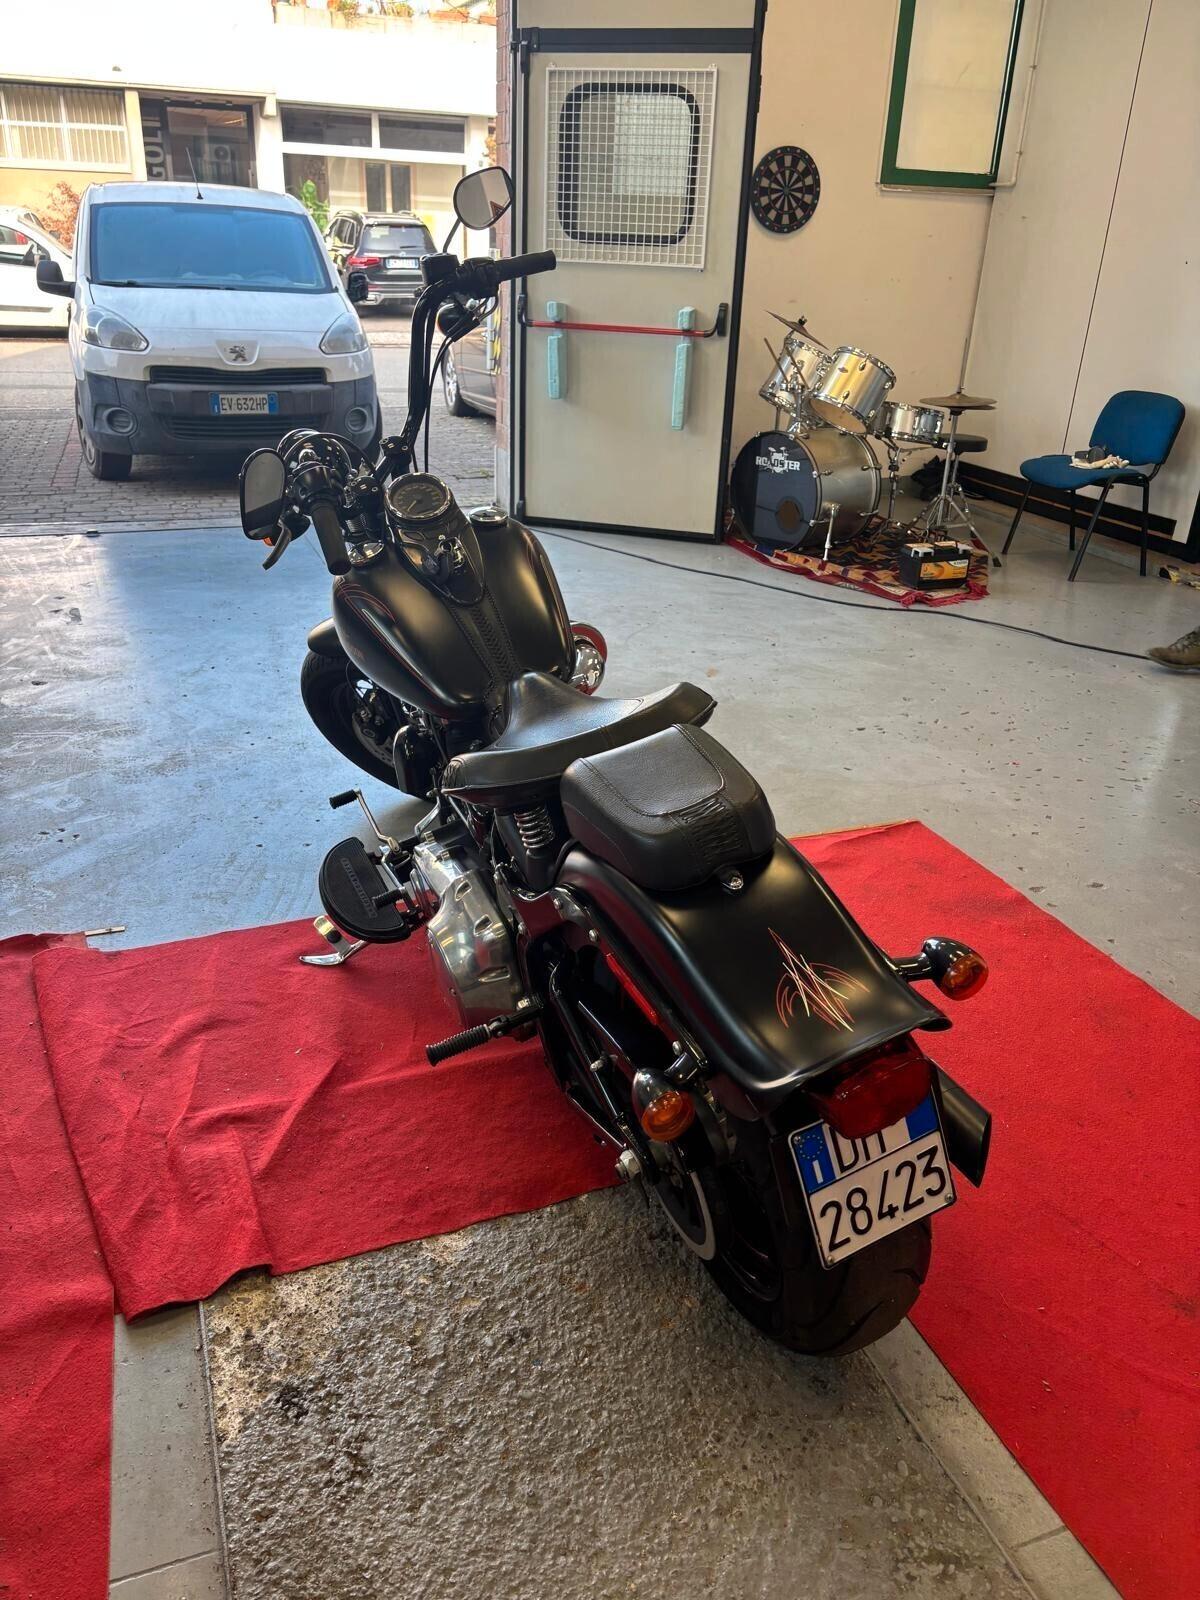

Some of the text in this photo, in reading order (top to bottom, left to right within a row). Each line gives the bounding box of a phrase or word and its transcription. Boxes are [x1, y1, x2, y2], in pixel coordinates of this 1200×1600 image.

[220, 397, 268, 411] EV 632HP
[820, 1145, 947, 1252] 28423
